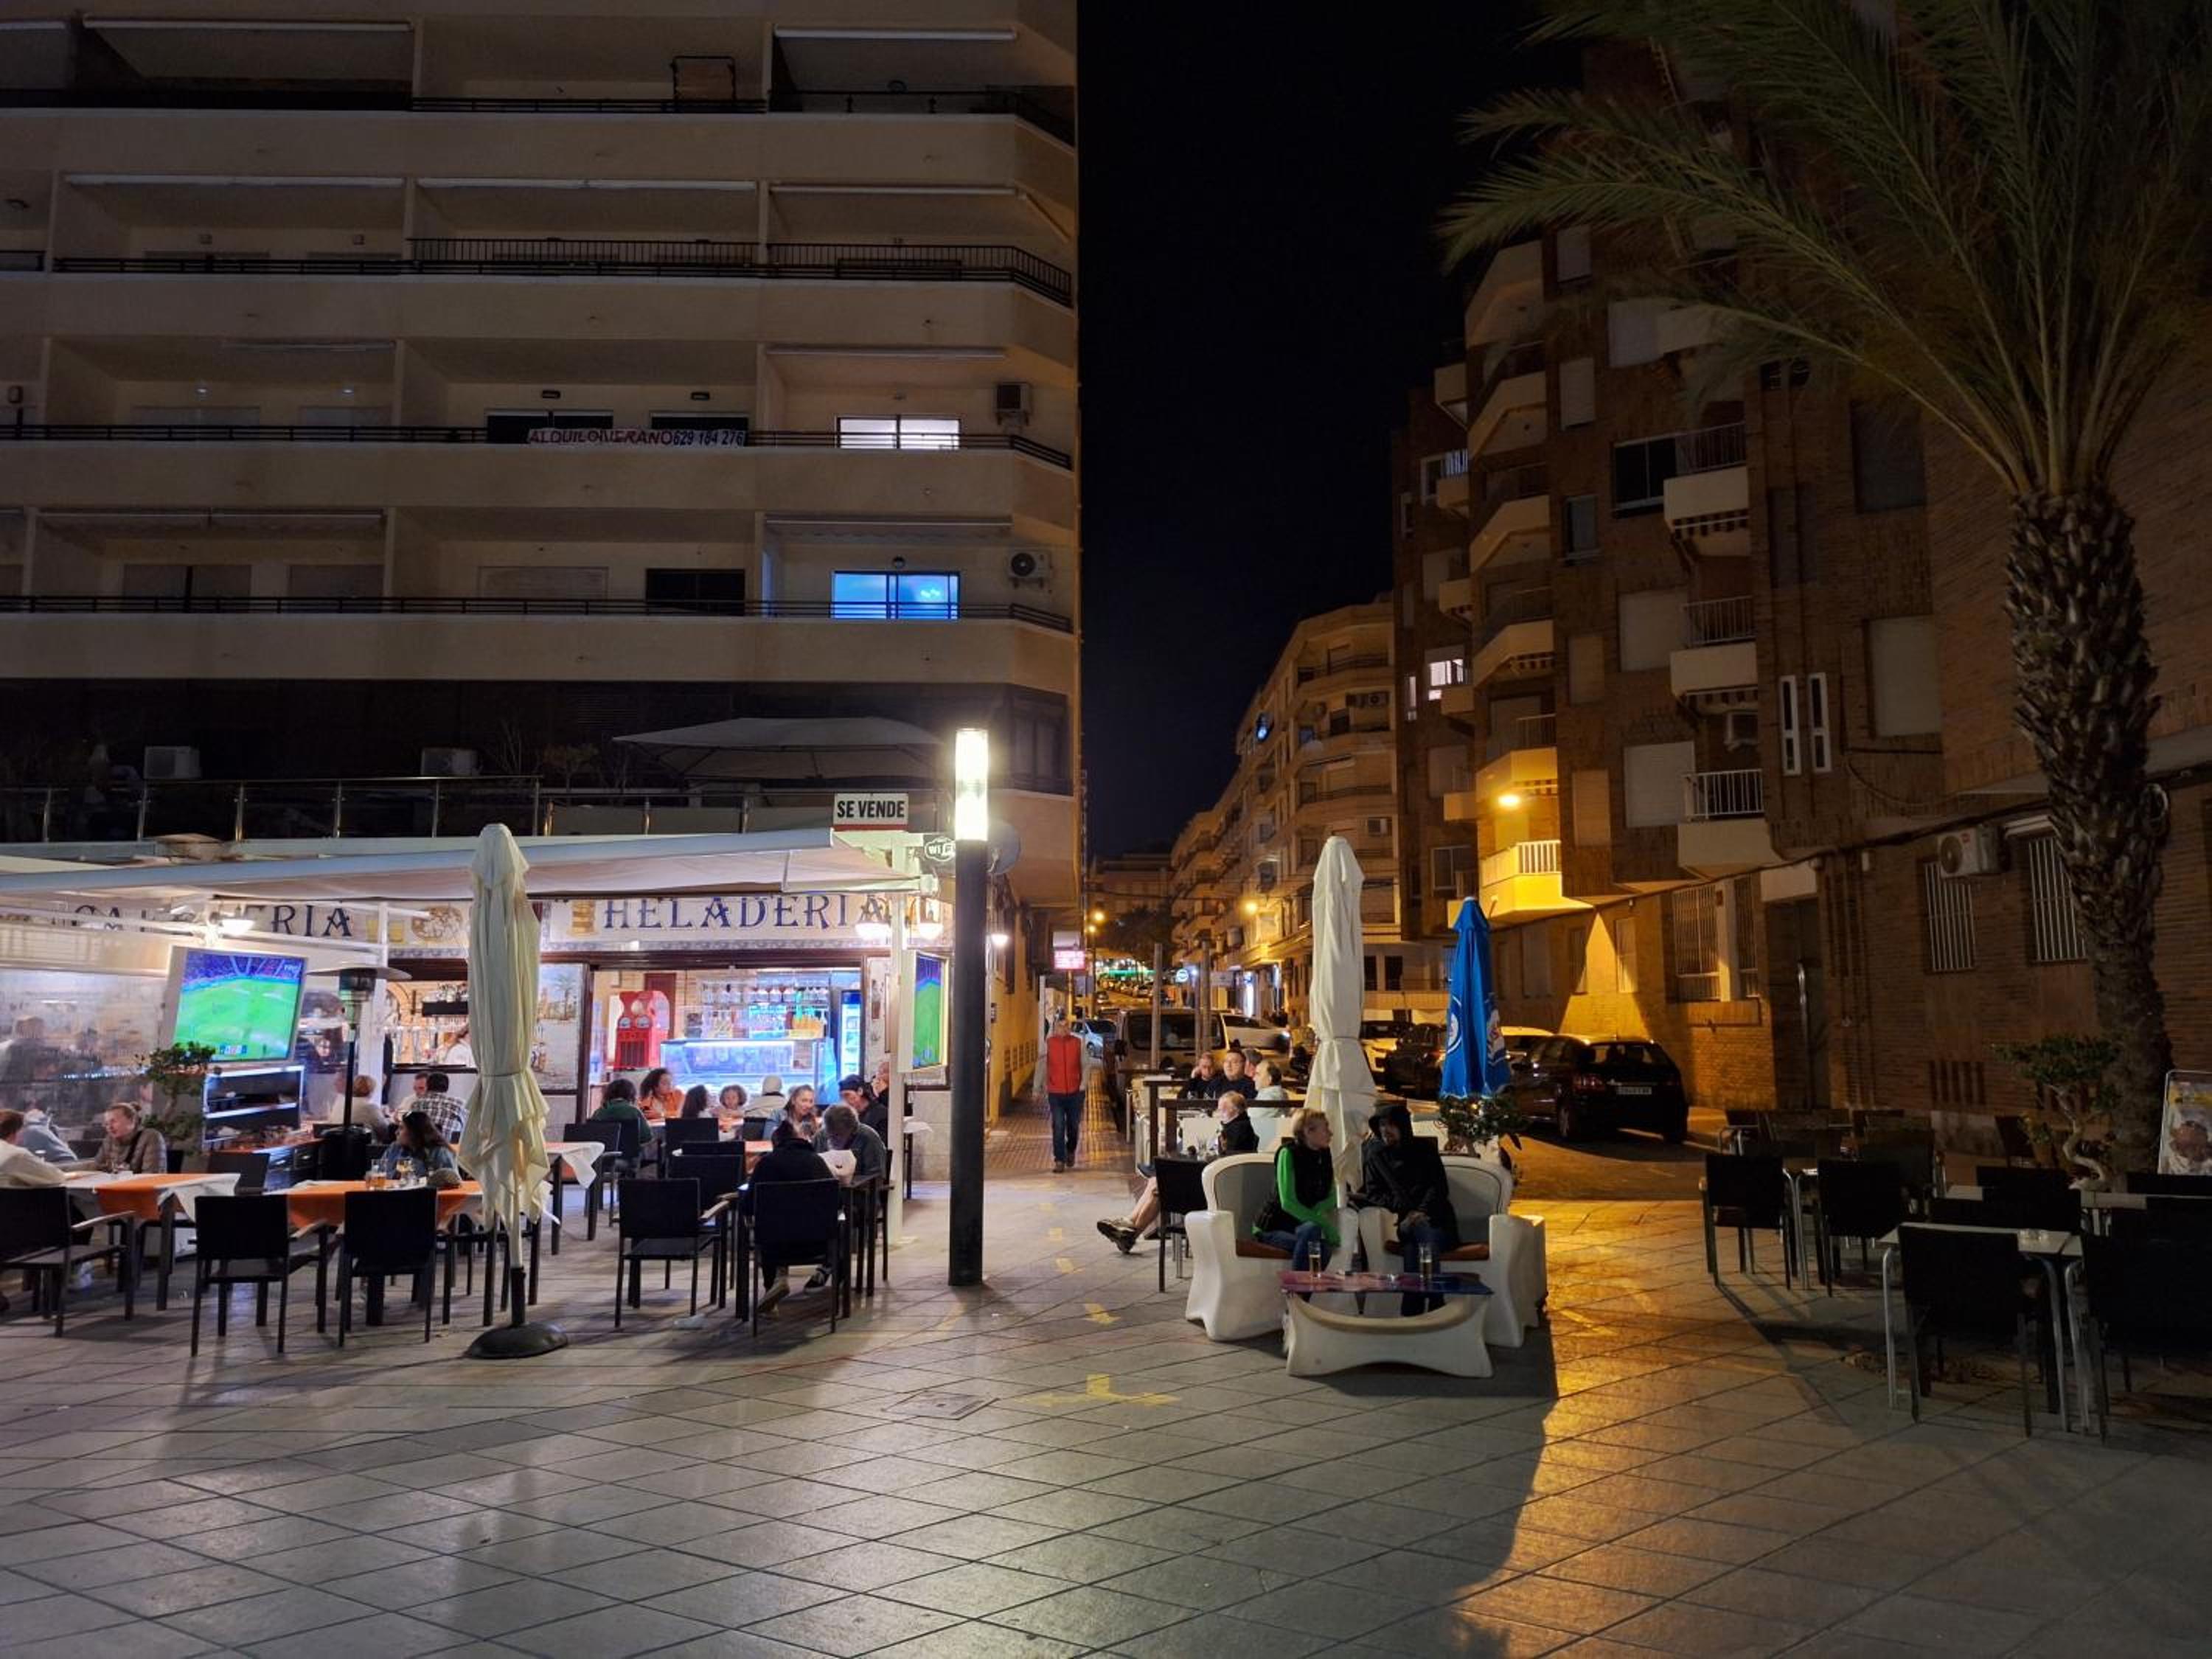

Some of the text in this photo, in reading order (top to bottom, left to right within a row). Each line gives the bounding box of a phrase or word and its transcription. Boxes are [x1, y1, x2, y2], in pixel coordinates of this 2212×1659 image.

[837, 800, 905, 818] SE VENDE
[604, 894, 886, 929] HELADERIA
